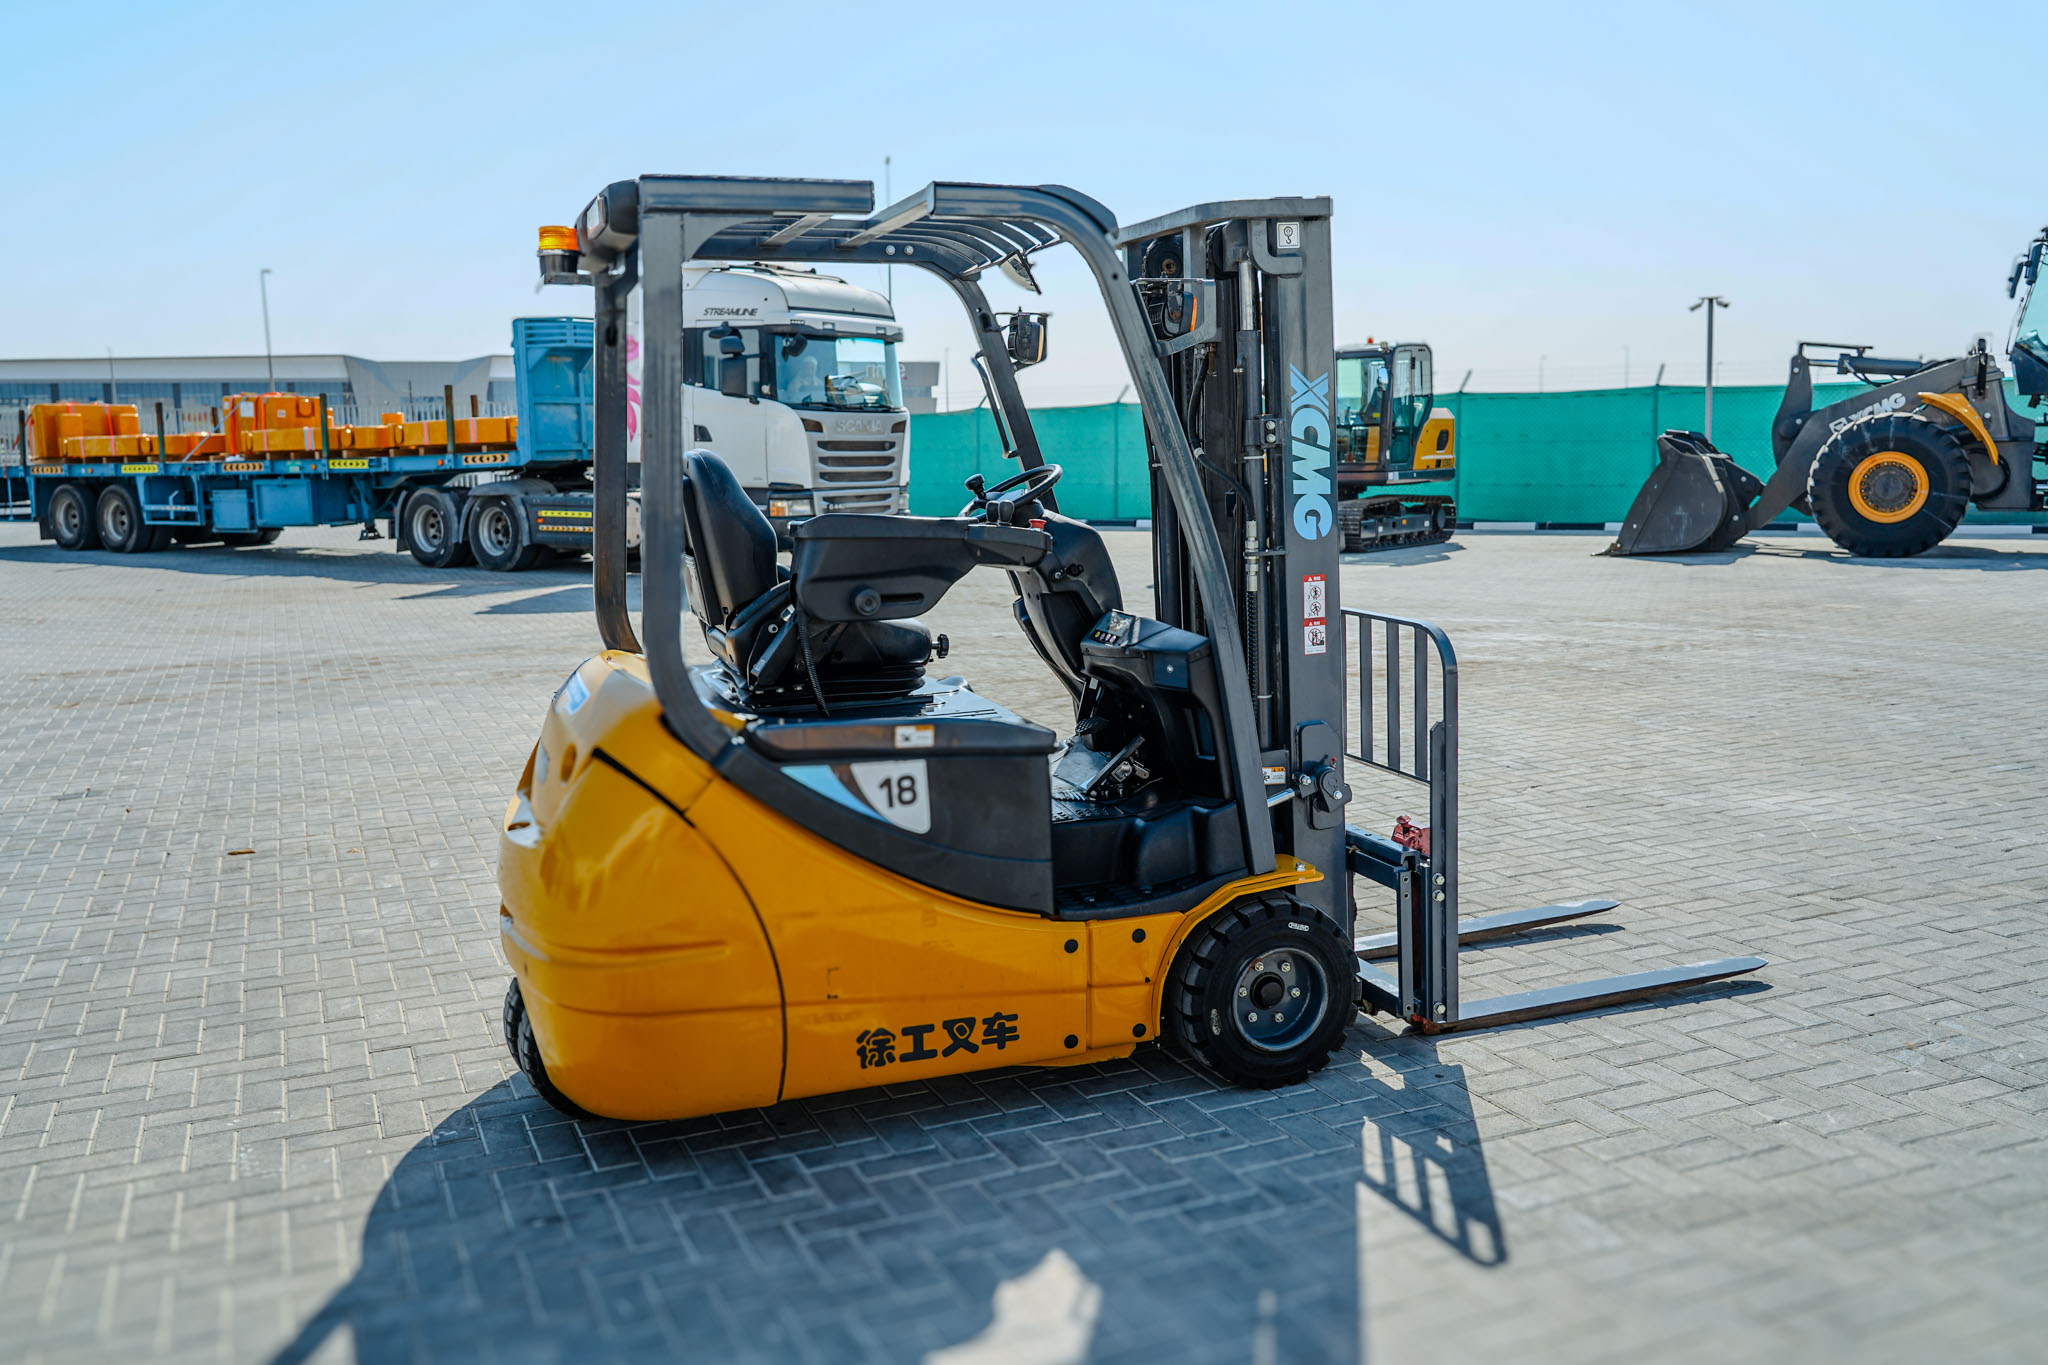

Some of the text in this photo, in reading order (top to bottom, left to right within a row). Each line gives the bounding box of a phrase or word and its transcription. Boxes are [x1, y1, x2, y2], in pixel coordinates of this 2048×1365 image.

[703, 307, 758, 316] STREAMLINE
[836, 419, 884, 433] SCANIA
[1289, 362, 1333, 541] XCMG
[879, 775, 917, 808] 18
[856, 1011, 1020, 1069] 徐工叉车
